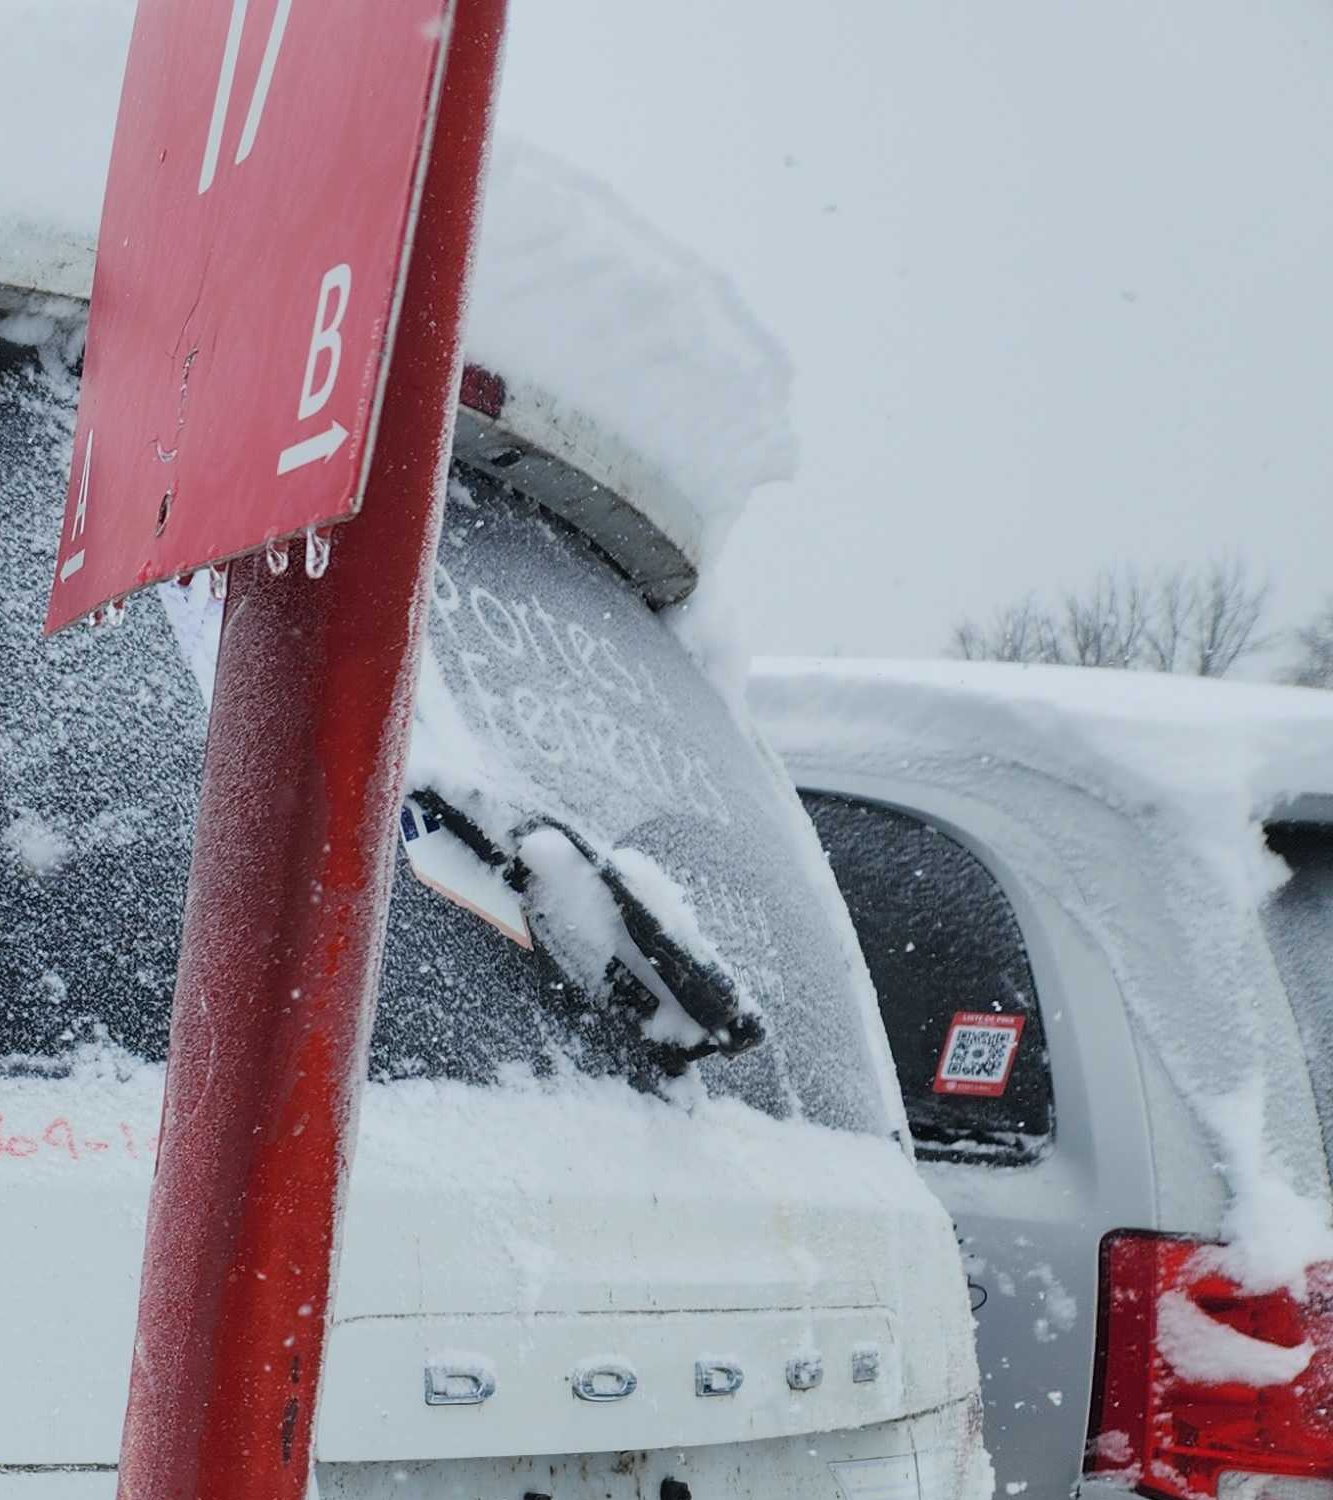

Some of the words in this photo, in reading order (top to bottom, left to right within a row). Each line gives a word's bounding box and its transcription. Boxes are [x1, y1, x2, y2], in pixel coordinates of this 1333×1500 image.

[297, 263, 352, 421] B
[70, 429, 94, 542] A
[424, 1348, 881, 1405] DODGE
